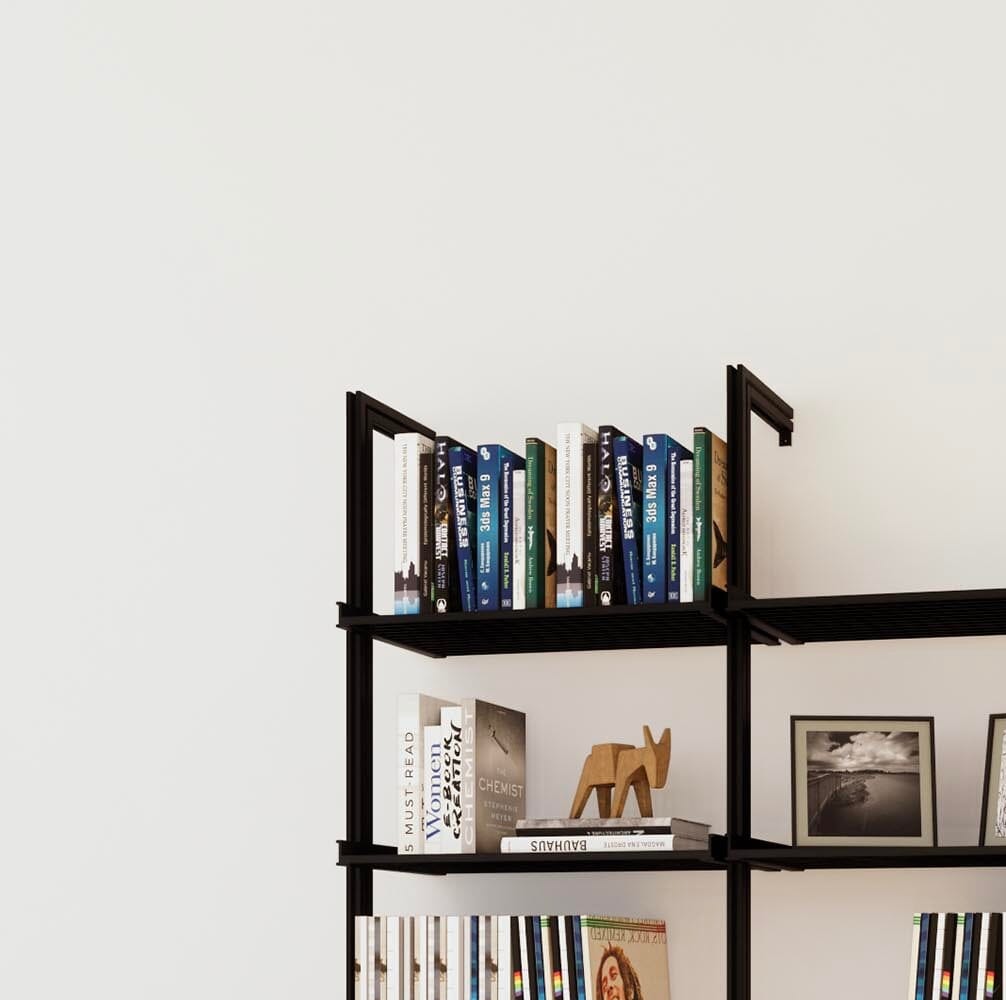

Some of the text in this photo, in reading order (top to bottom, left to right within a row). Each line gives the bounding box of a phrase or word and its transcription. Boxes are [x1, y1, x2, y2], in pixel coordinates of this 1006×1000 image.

[436, 442, 446, 502] HALO
[601, 432, 611, 492] HALO
[646, 464, 657, 472] 9
[455, 465, 469, 548] BUSINESS
[480, 484, 490, 508] Max
[617, 456, 628, 539] COMMUNICATIONS
[620, 455, 634, 540] BUSINESS
[646, 475, 657, 499] Max
[480, 511, 490, 532] 3ds
[646, 502, 657, 523] 3ds
[426, 743, 441, 840] Women
[443, 733, 452, 828] E-BOOK
[450, 720, 462, 839] CREATION
[465, 709, 473, 845] CHEMIST
[478, 777, 523, 798] CHEMIST
[491, 812, 511, 824] MEYER
[405, 844, 414, 852] 5
[531, 840, 587, 852] BAUHAUS
